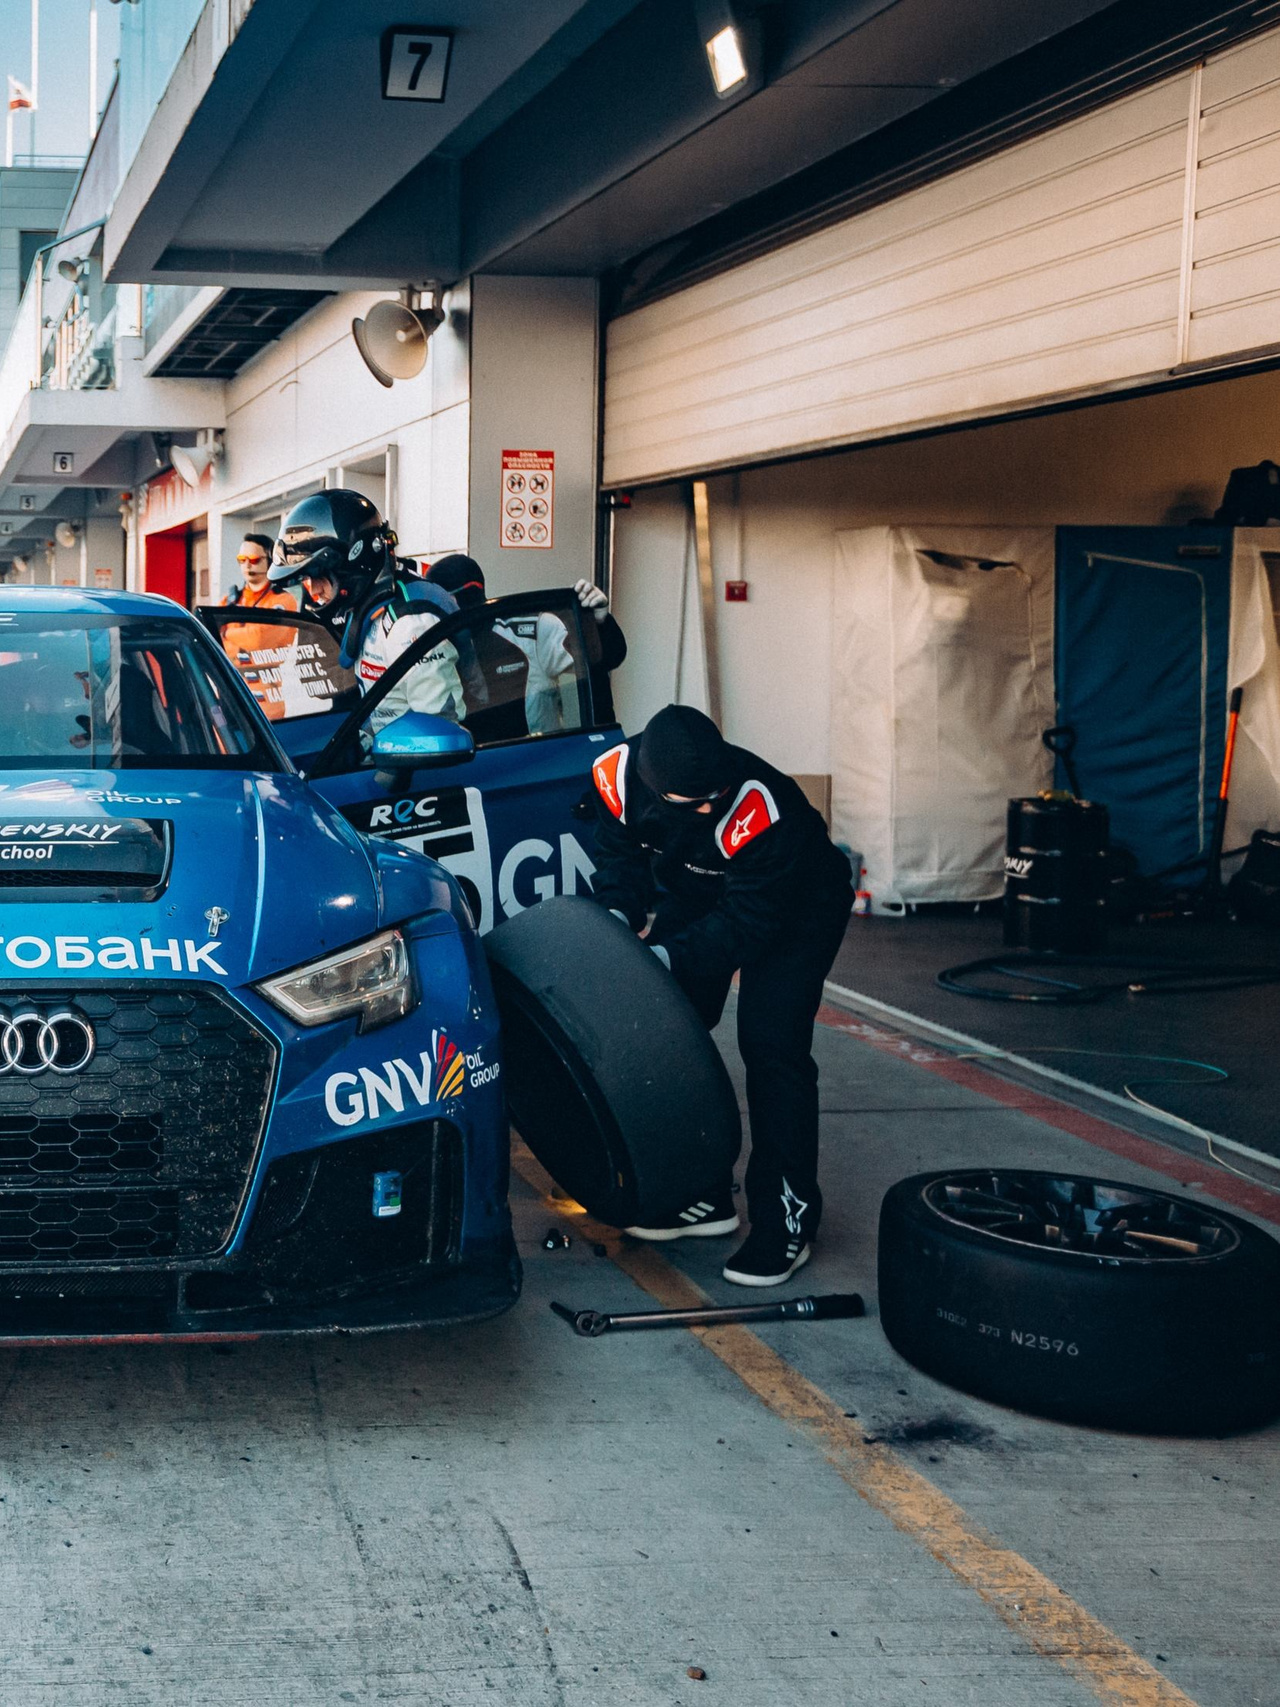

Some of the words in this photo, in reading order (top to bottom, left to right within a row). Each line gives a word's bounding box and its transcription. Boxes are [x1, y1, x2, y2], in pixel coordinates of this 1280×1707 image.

[407, 41, 433, 91] 7
[59, 456, 68, 470] 6
[24, 497, 32, 508] 5
[86, 796, 182, 805] GROUP
[466, 1052, 485, 1071] OIL
[470, 1062, 501, 1088] GROUP
[324, 1051, 432, 1127] GNV
[1010, 1329, 1080, 1356] N2596
